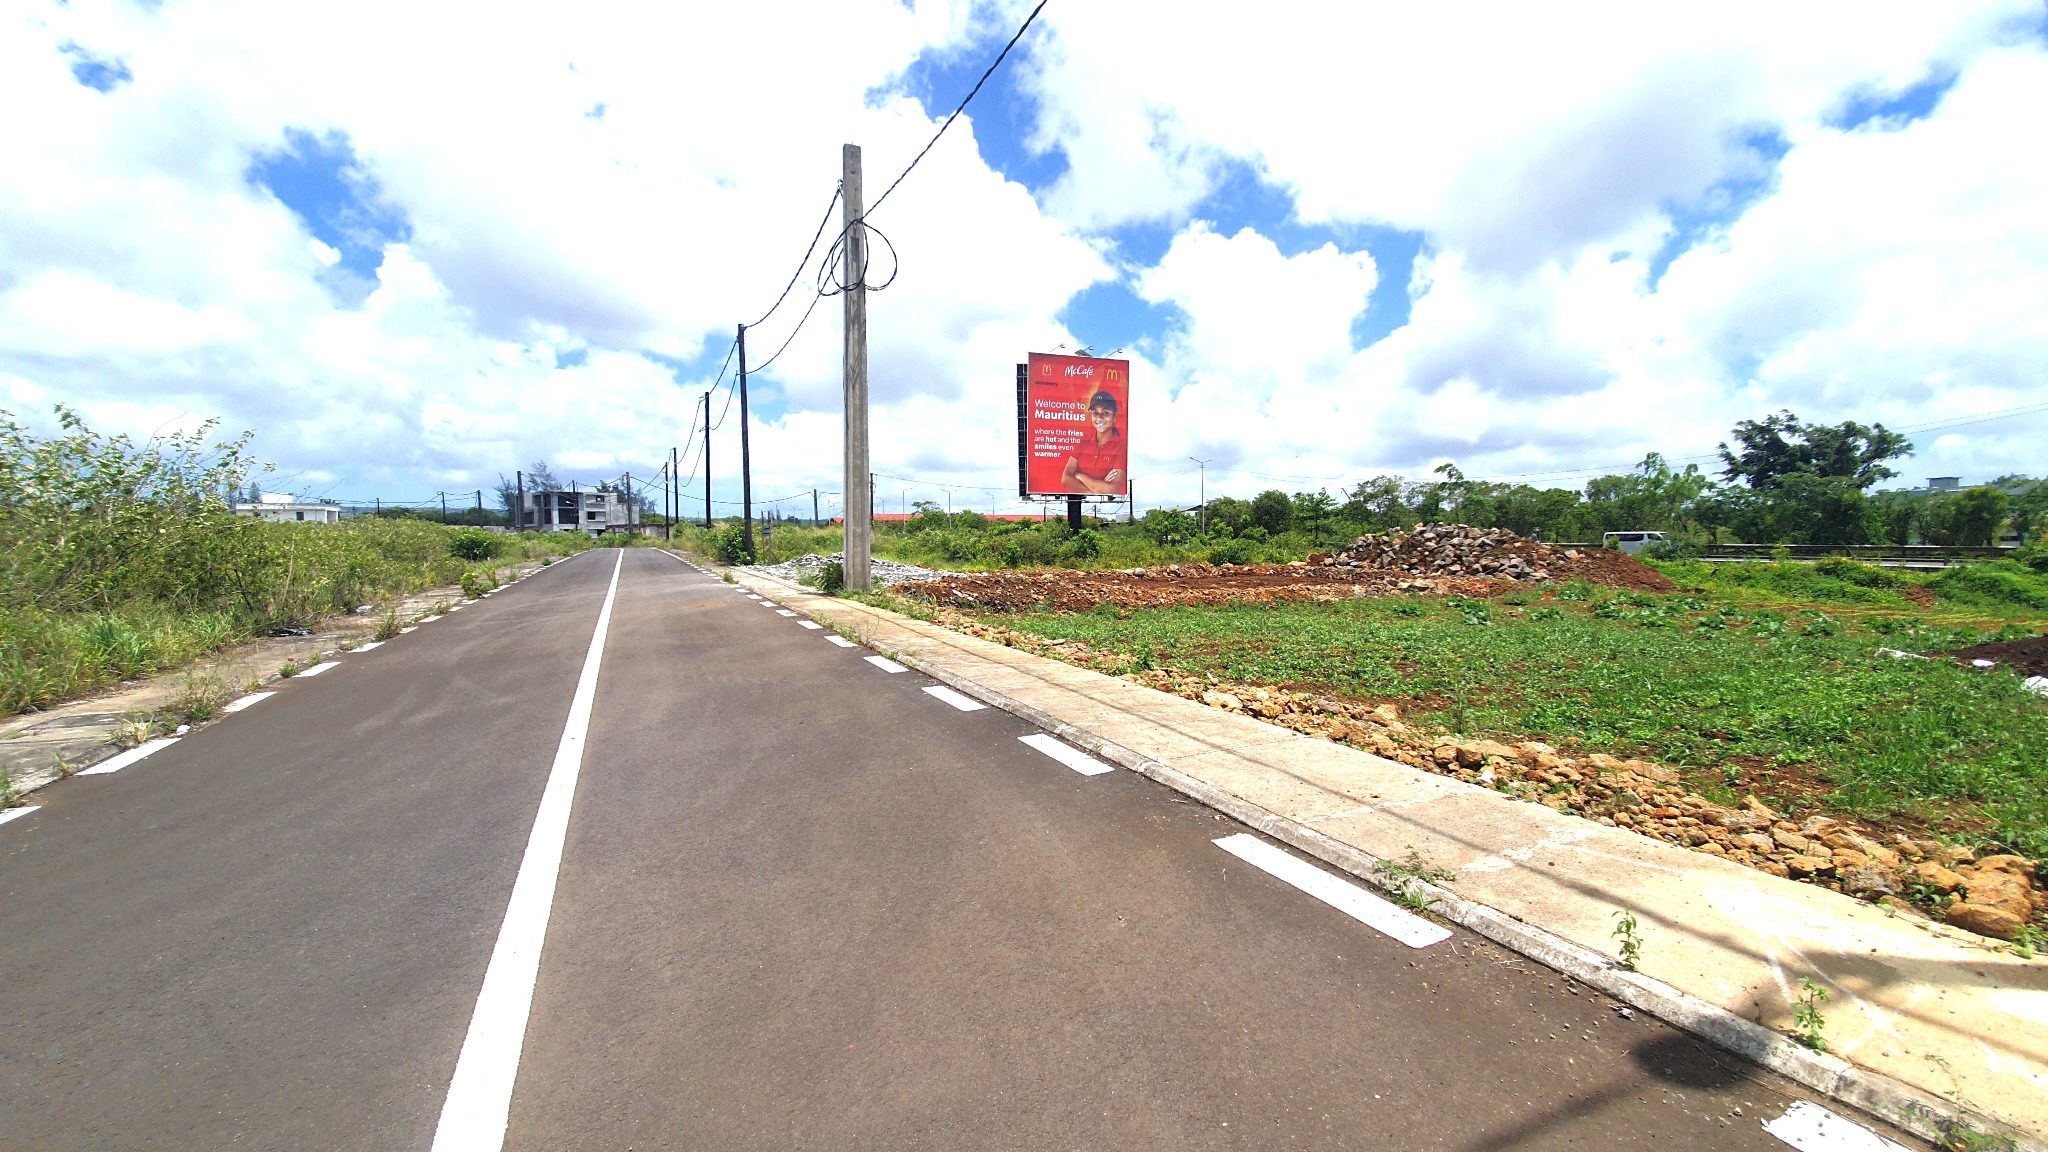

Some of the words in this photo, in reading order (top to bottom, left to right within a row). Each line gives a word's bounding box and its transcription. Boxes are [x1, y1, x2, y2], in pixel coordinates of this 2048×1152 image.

[1035, 399, 1075, 410] Welcome
[1077, 402, 1086, 410] to
[1035, 409, 1086, 421] Mauritius
[1035, 428, 1055, 436] where
